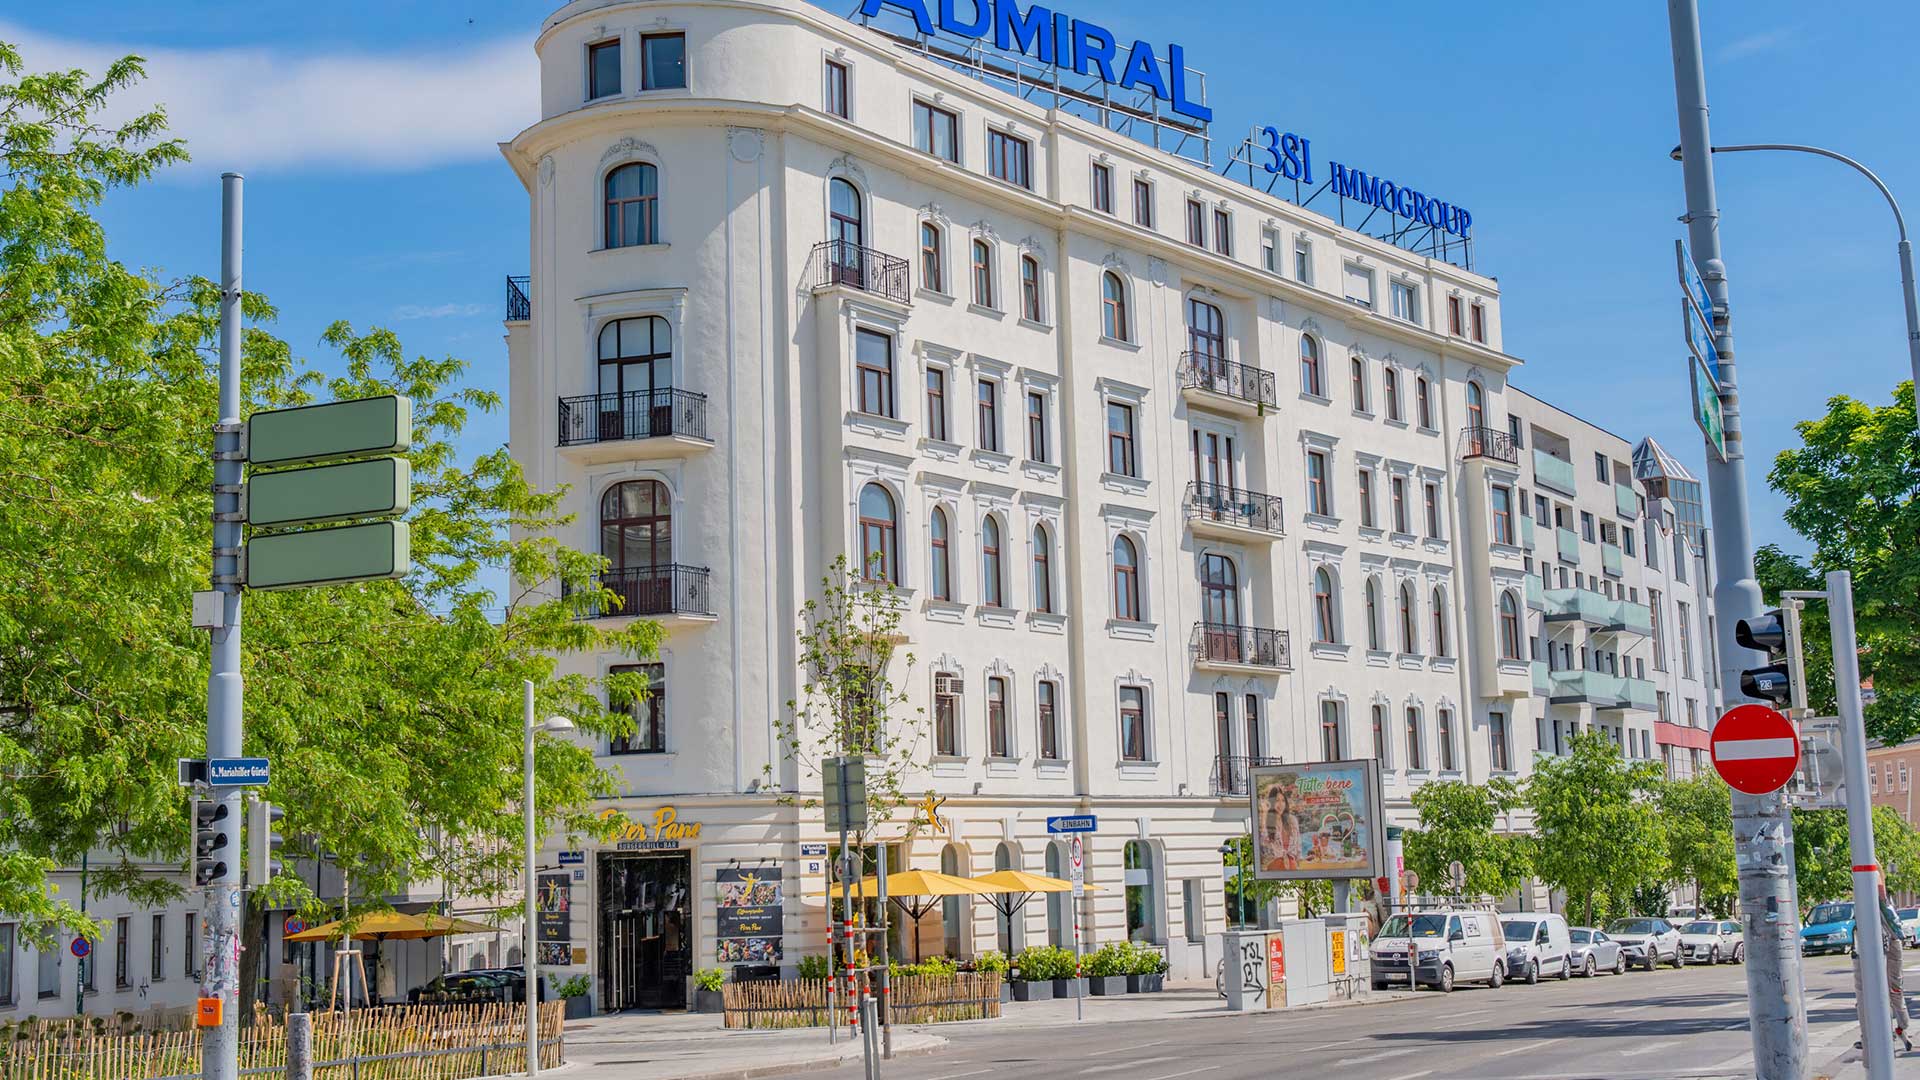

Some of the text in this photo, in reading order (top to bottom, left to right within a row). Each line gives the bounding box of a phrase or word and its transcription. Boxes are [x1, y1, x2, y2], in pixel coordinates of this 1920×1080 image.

[1262, 126, 1473, 239] 3SI IMMOGROUP
[218, 766, 250, 777] Mariahilfer
[1296, 777, 1322, 794] Tutto
[1325, 775, 1353, 790] bene
[651, 806, 702, 842] Pane
[1062, 820, 1091, 828] EINBAHN
